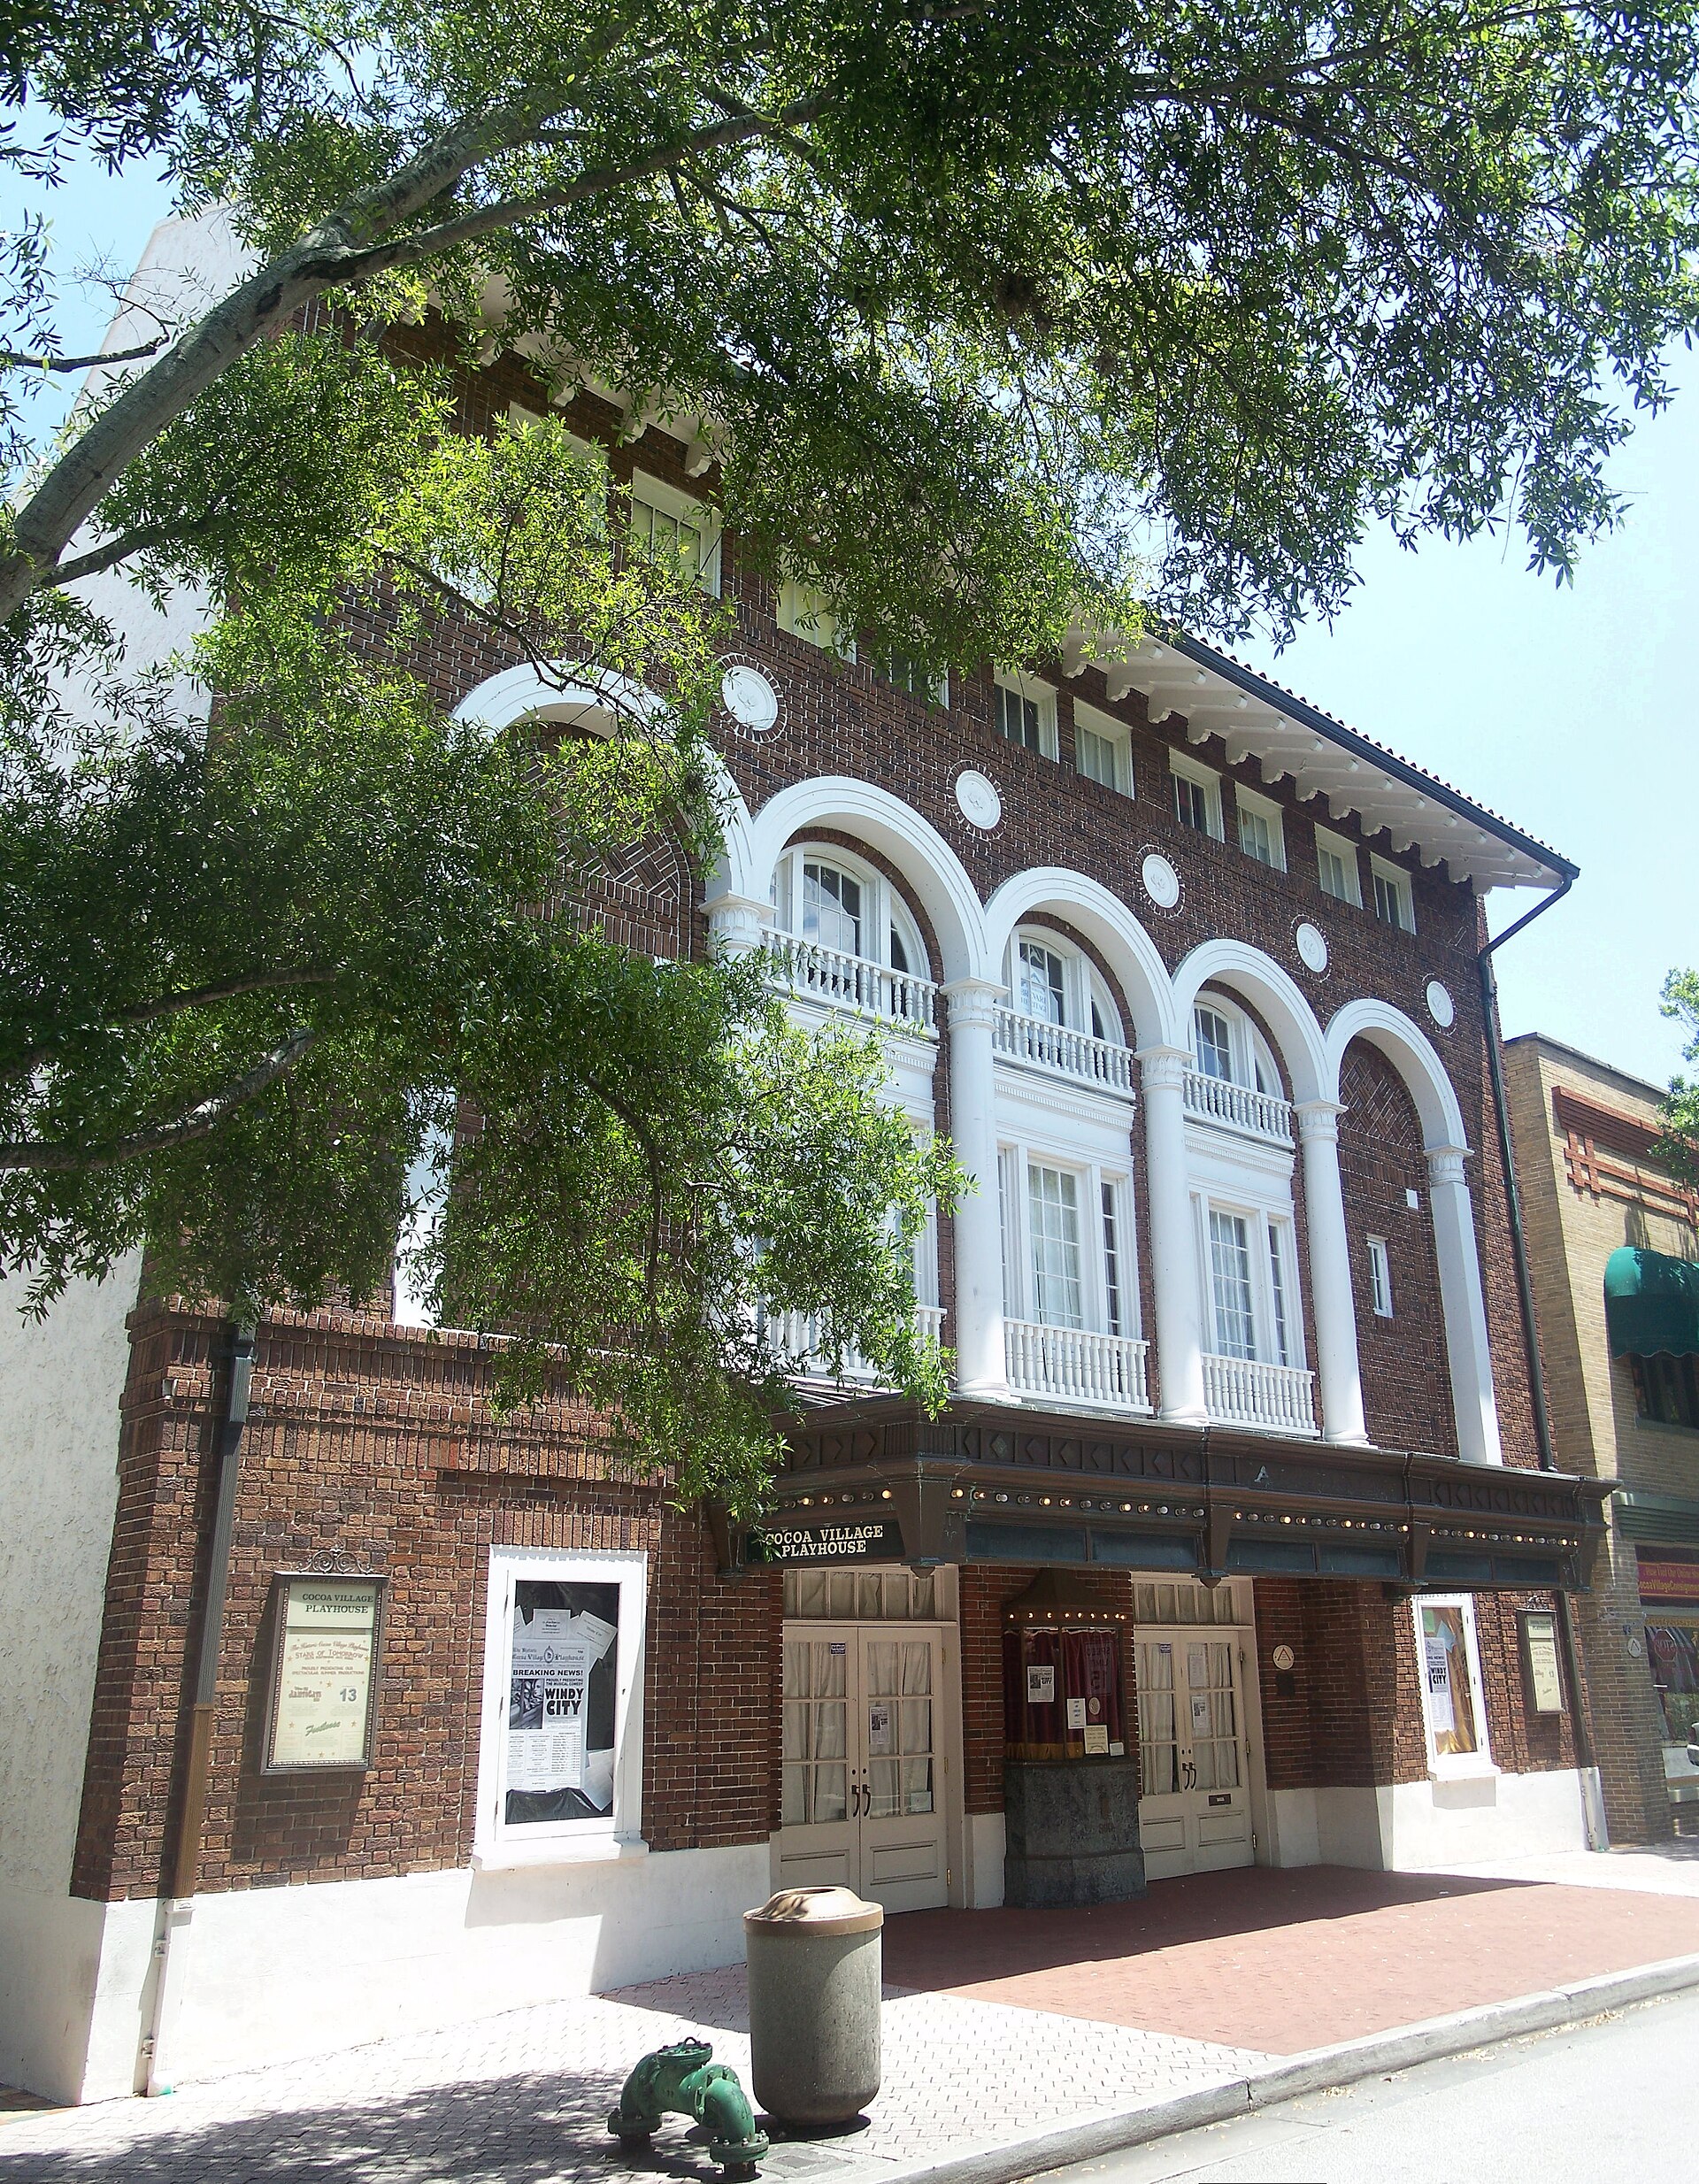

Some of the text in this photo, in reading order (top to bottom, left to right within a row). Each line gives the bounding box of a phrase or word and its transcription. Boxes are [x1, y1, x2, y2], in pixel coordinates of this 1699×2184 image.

[765, 1525, 883, 1545] COCOA VILLAGE
[781, 1540, 866, 1557] PLAYHOUSE
[334, 1594, 373, 1603] VILLAGE
[305, 1604, 368, 1613] PLAYHOUSE
[329, 1649, 364, 1658] TOMORROW
[1433, 1674, 1446, 1684] CITY
[340, 1688, 357, 1702] 13
[545, 1688, 584, 1699] WINDY
[546, 1700, 581, 1715] CITY
